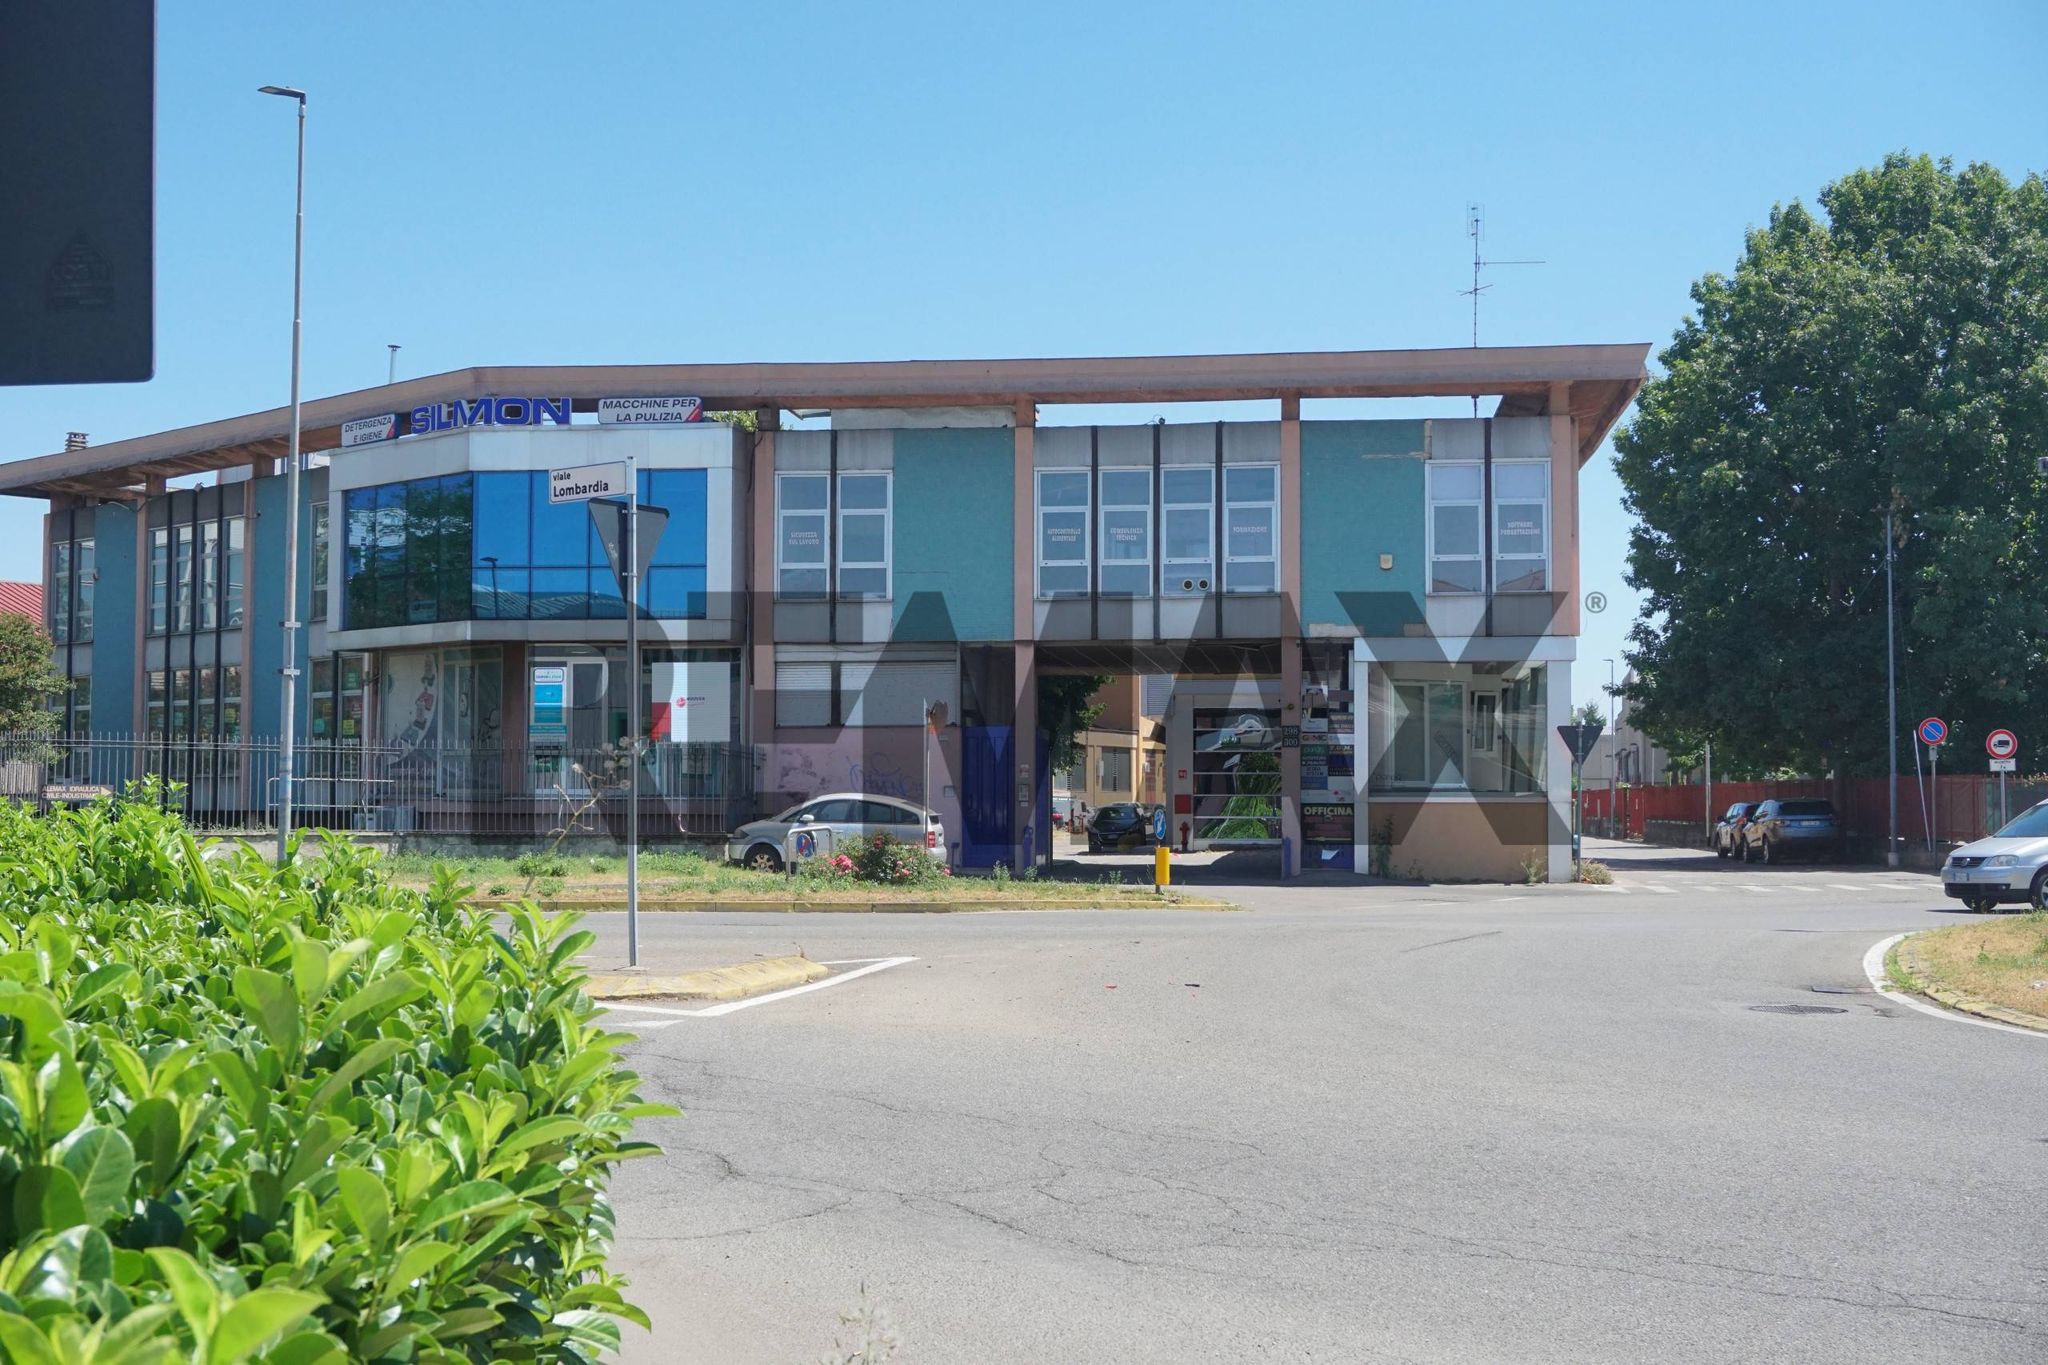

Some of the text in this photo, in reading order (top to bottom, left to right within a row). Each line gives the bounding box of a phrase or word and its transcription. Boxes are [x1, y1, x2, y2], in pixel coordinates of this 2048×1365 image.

[602, 399, 697, 410] MACCHINE PER
[411, 397, 571, 434] SILMON
[616, 412, 683, 422] LA PULIZIA
[344, 416, 392, 433] DETERGENZA
[353, 430, 383, 443] E IGIENE
[553, 472, 571, 482] viale
[553, 480, 609, 498] Lombardia
[1304, 806, 1353, 816] OFFICINA
